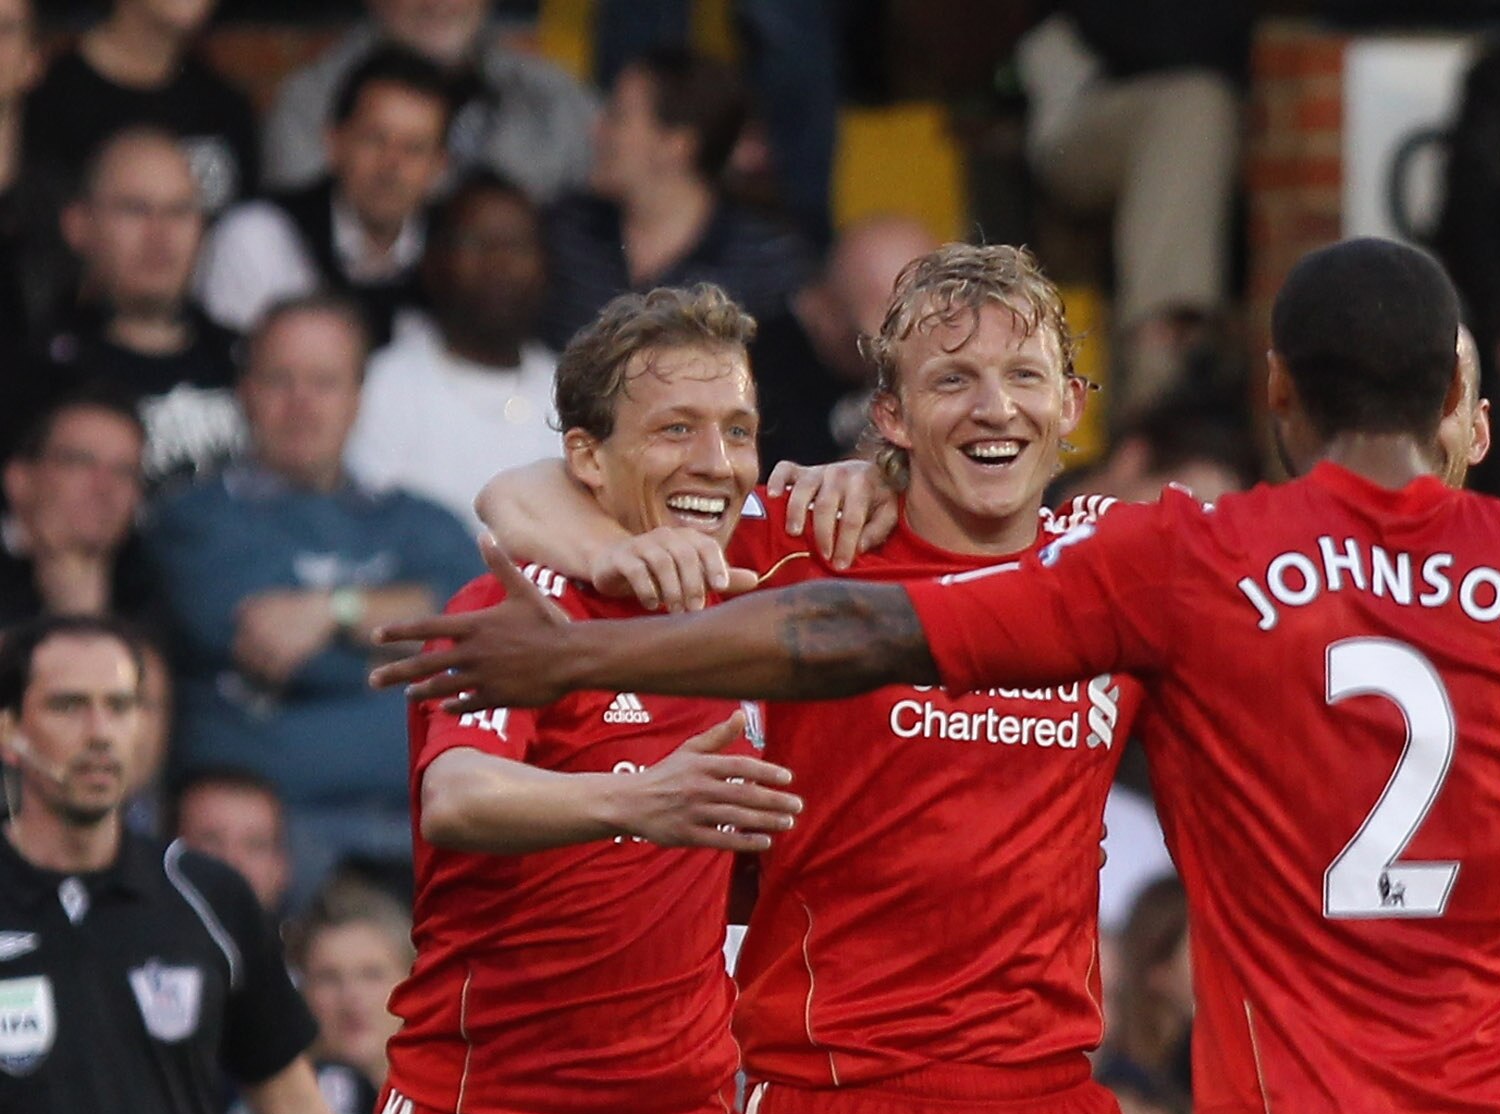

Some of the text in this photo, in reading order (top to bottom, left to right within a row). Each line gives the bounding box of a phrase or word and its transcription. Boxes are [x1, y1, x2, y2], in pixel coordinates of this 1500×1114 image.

[603, 710, 651, 724] adidas
[890, 699, 1079, 749] Chartered
[1323, 635, 1460, 919] 2
